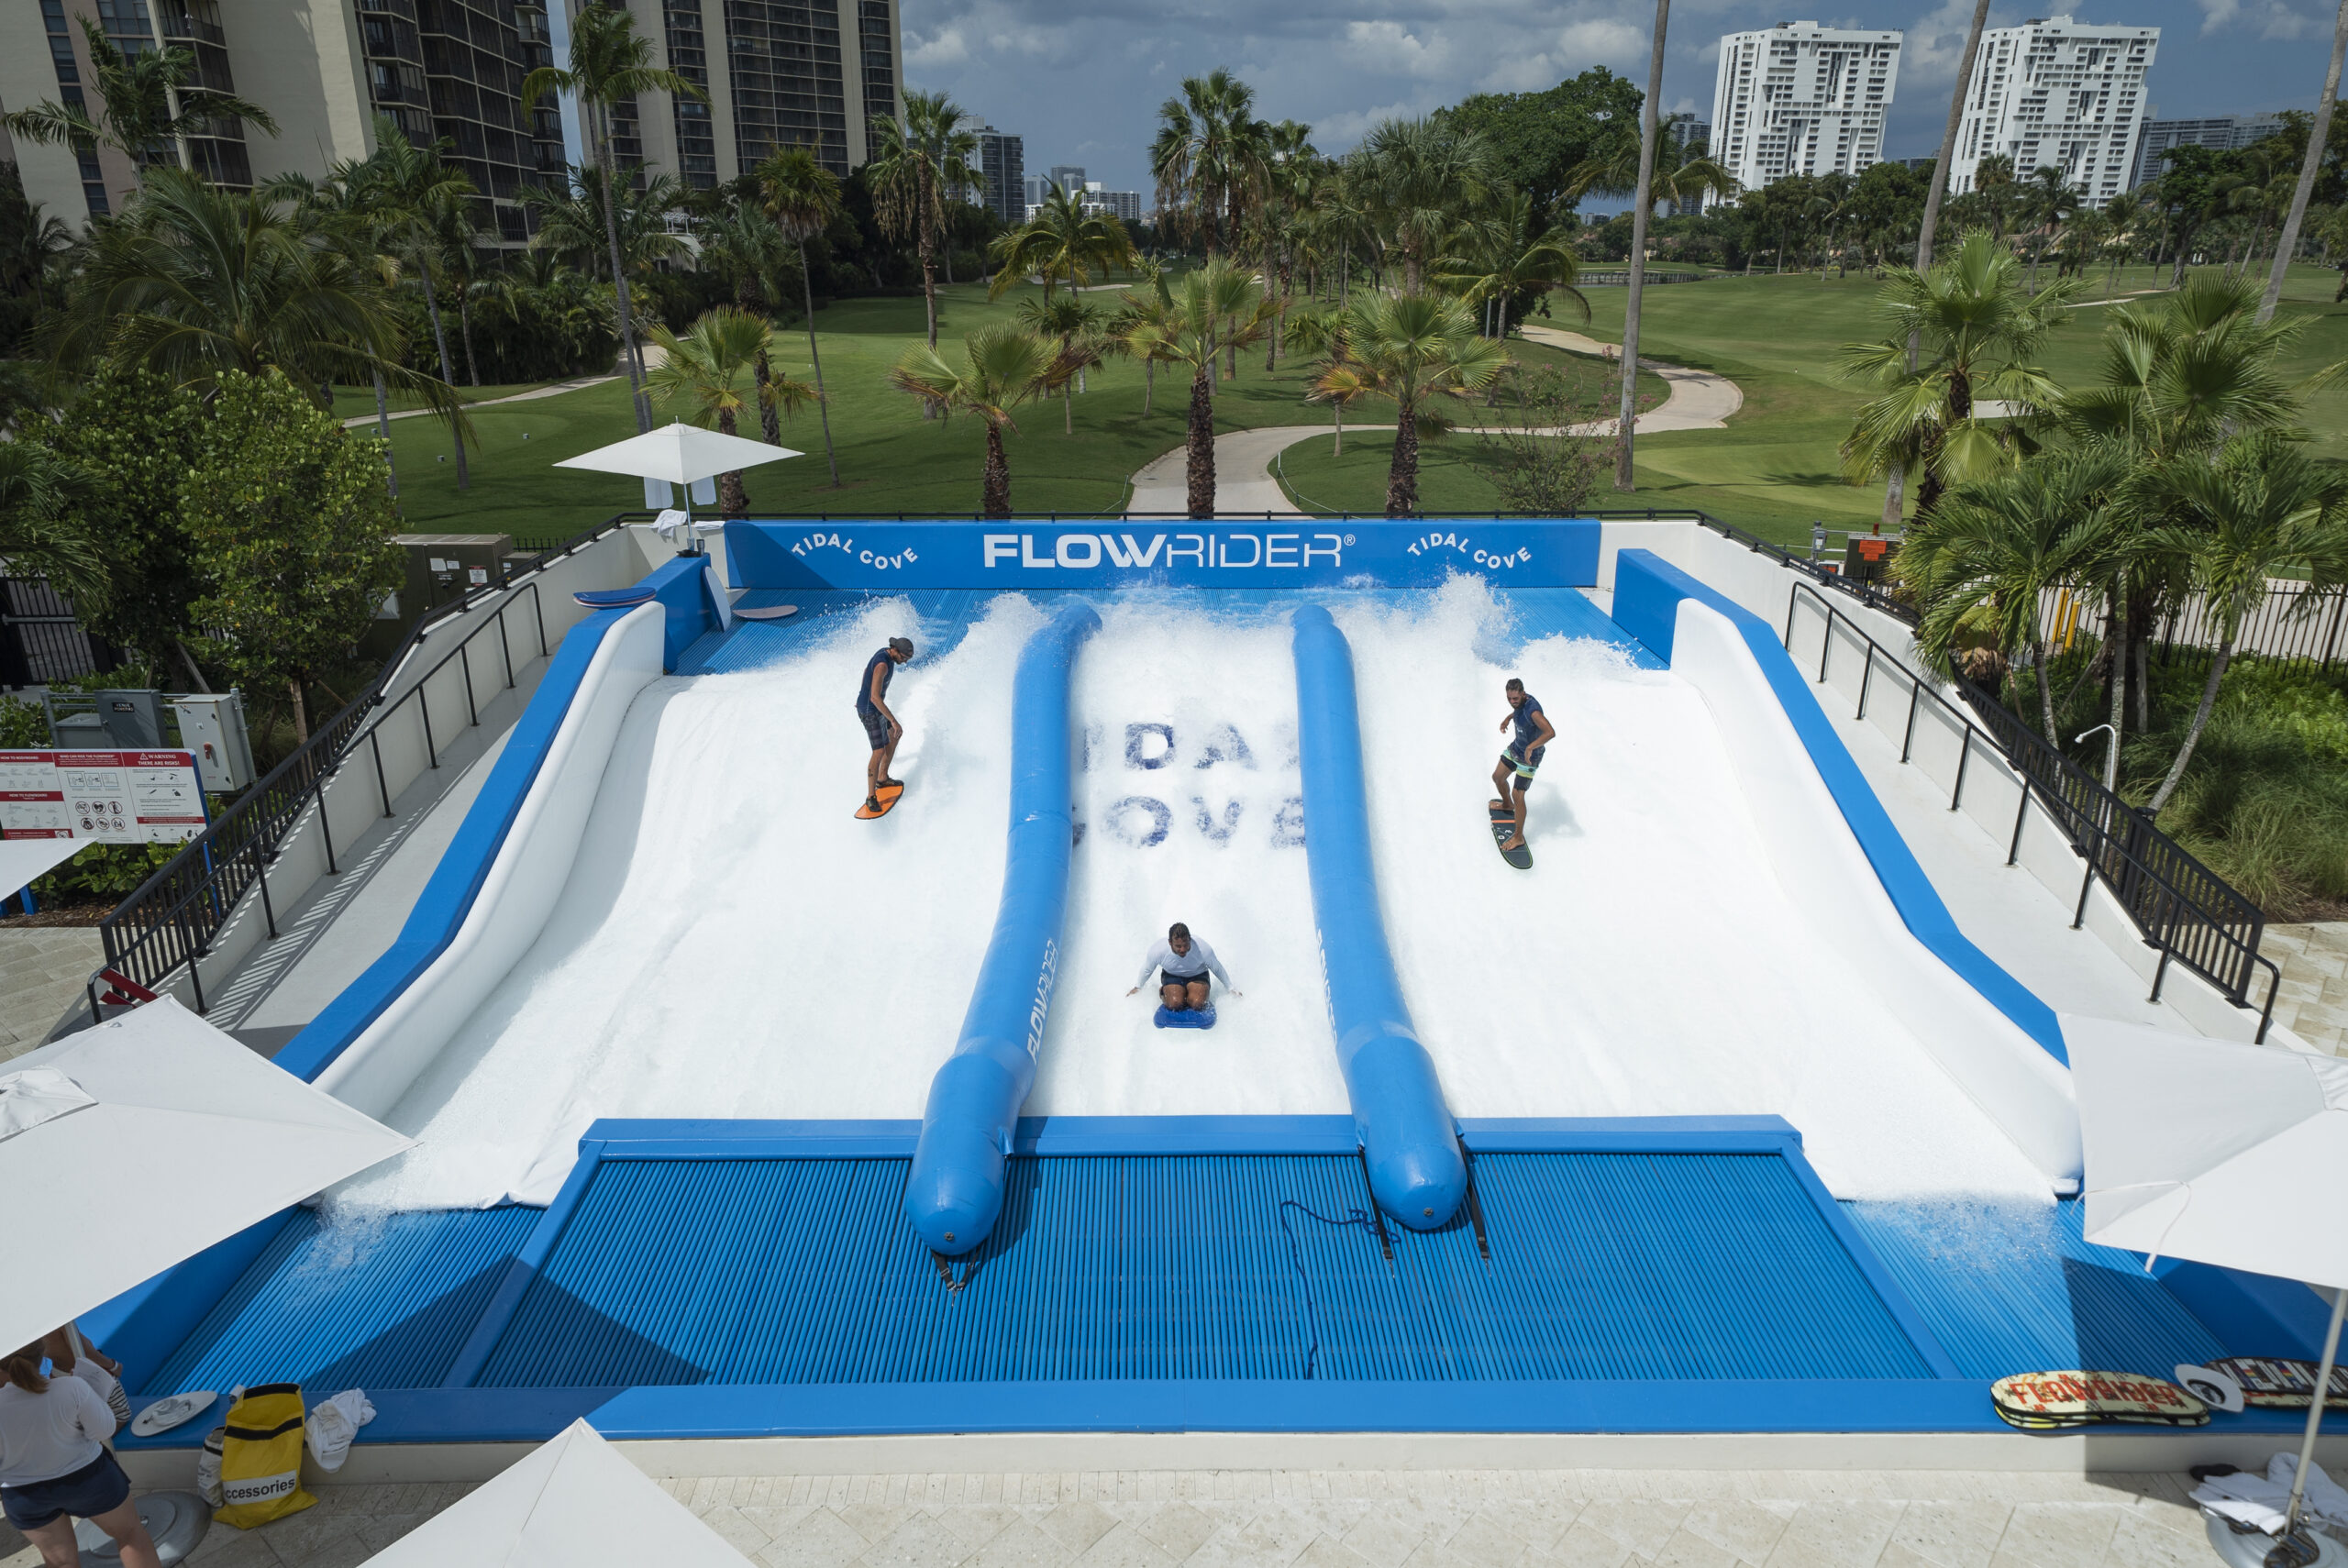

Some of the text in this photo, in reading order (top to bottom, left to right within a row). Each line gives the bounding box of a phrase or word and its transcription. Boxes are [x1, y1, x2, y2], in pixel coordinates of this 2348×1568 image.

[792, 533, 918, 569] TIDAL COVE
[1407, 533, 1532, 569] TIDAL COVE
[1072, 796, 1306, 849] OVE
[2008, 1378, 2187, 1408] FLOWRIDER
[226, 1479, 295, 1499] ccessories
